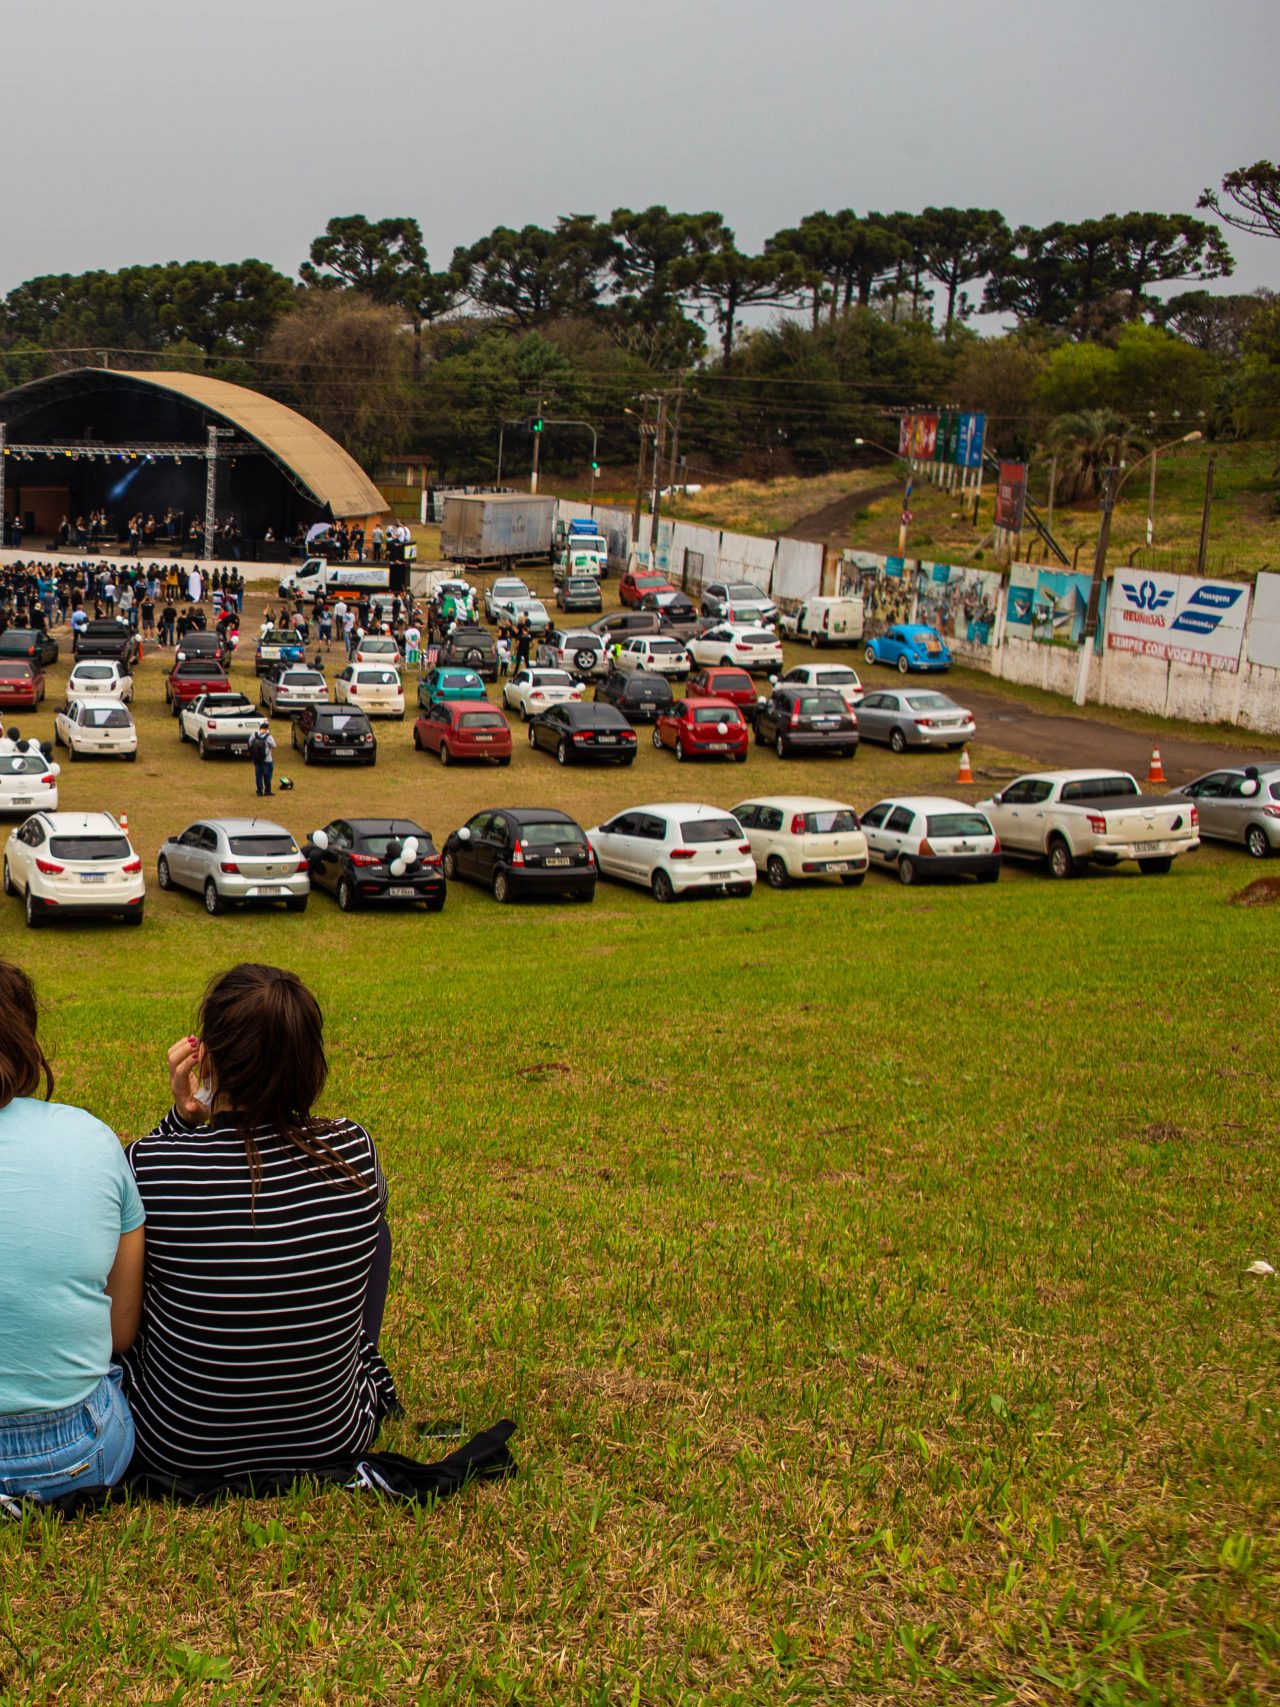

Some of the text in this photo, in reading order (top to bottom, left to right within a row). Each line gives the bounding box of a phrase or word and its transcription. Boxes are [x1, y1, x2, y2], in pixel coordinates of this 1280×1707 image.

[1199, 590, 1231, 604] Passagens
[1123, 610, 1166, 628] REUNIDAS
[1178, 616, 1214, 630] Encomendas
[1111, 634, 1145, 653] SEMPRE
[1145, 642, 1166, 659] COM
[1194, 650, 1209, 668] NA
